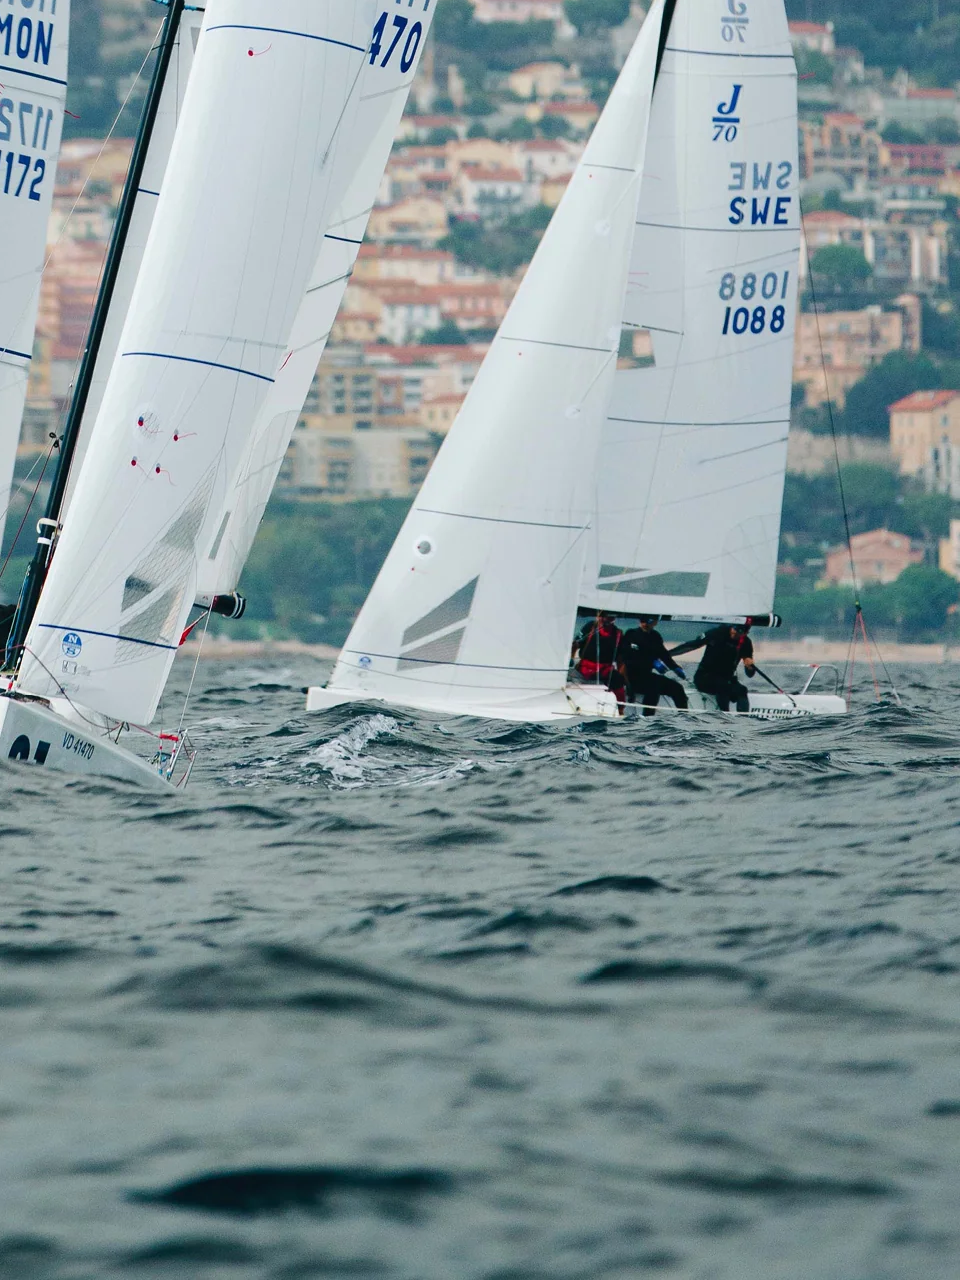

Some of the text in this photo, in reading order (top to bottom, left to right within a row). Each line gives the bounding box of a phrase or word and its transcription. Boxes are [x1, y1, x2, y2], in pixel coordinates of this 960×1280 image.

[369, 11, 423, 73] 470
[717, 84, 743, 115] J
[712, 124, 738, 143] 70
[728, 196, 792, 226] SWE
[722, 305, 785, 336] 1088
[62, 732, 95, 760] VD 41470
